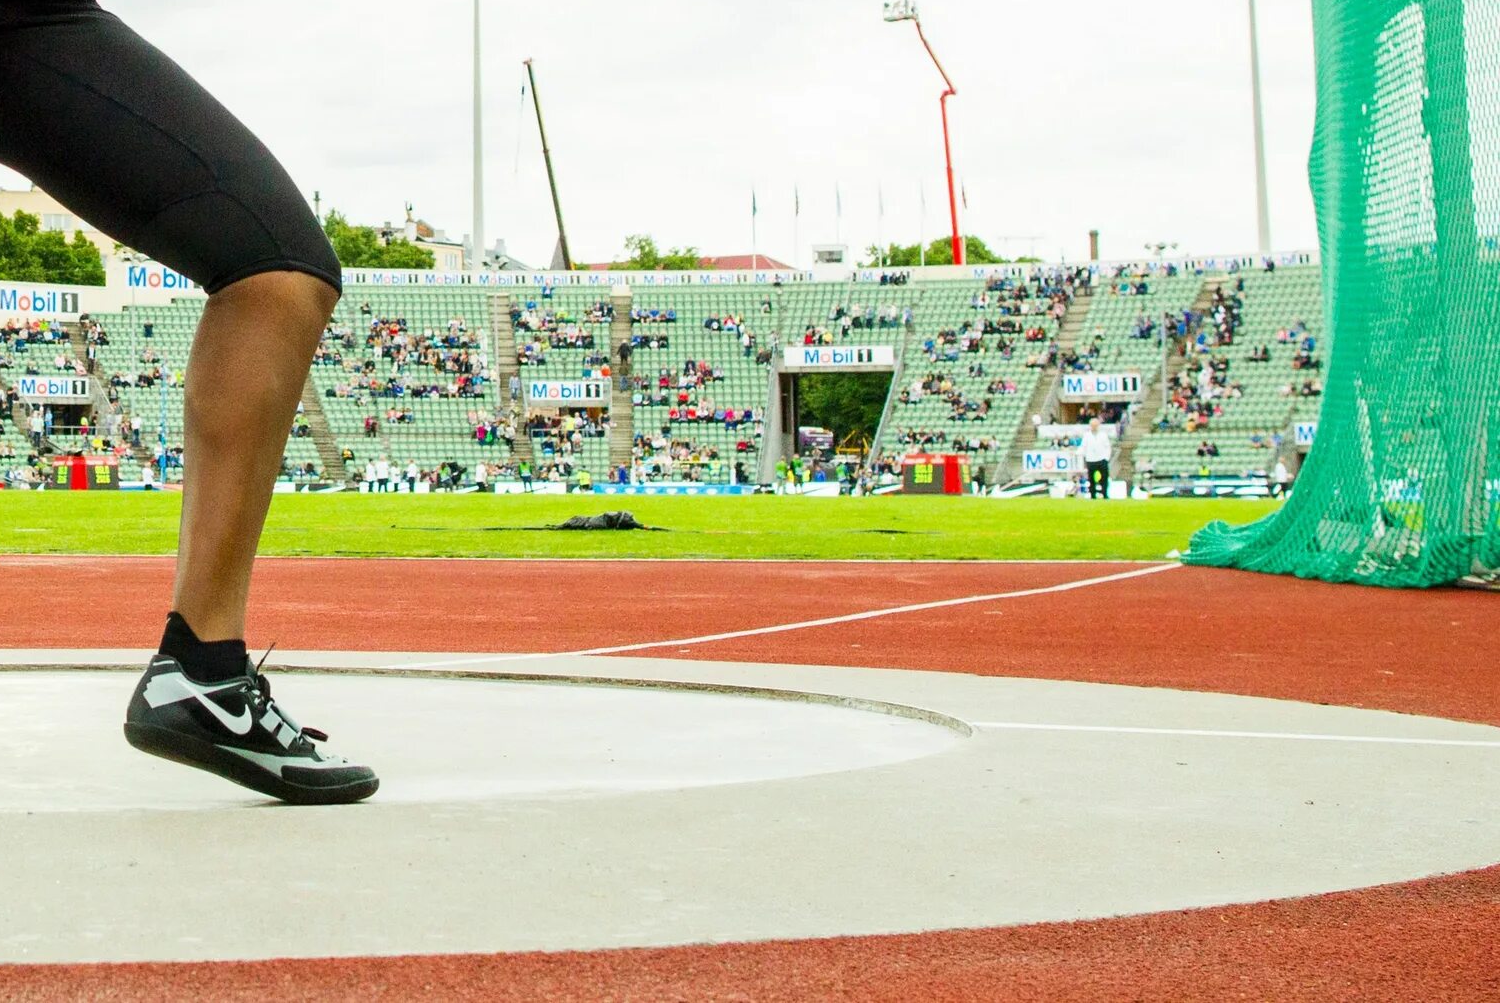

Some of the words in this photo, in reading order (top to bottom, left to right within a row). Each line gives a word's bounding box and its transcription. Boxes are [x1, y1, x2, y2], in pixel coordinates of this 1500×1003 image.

[372, 273, 406, 284] Mobil
[425, 274, 459, 284] Mobil
[479, 275, 512, 285] Mobil
[589, 275, 622, 285] Mobil
[644, 275, 678, 285] Mobil
[0, 289, 56, 313] Mobil
[804, 349, 853, 363] Mobil
[21, 379, 68, 394] Mobil
[532, 384, 581, 398] Mobil
[1067, 378, 1118, 392] Mobil
